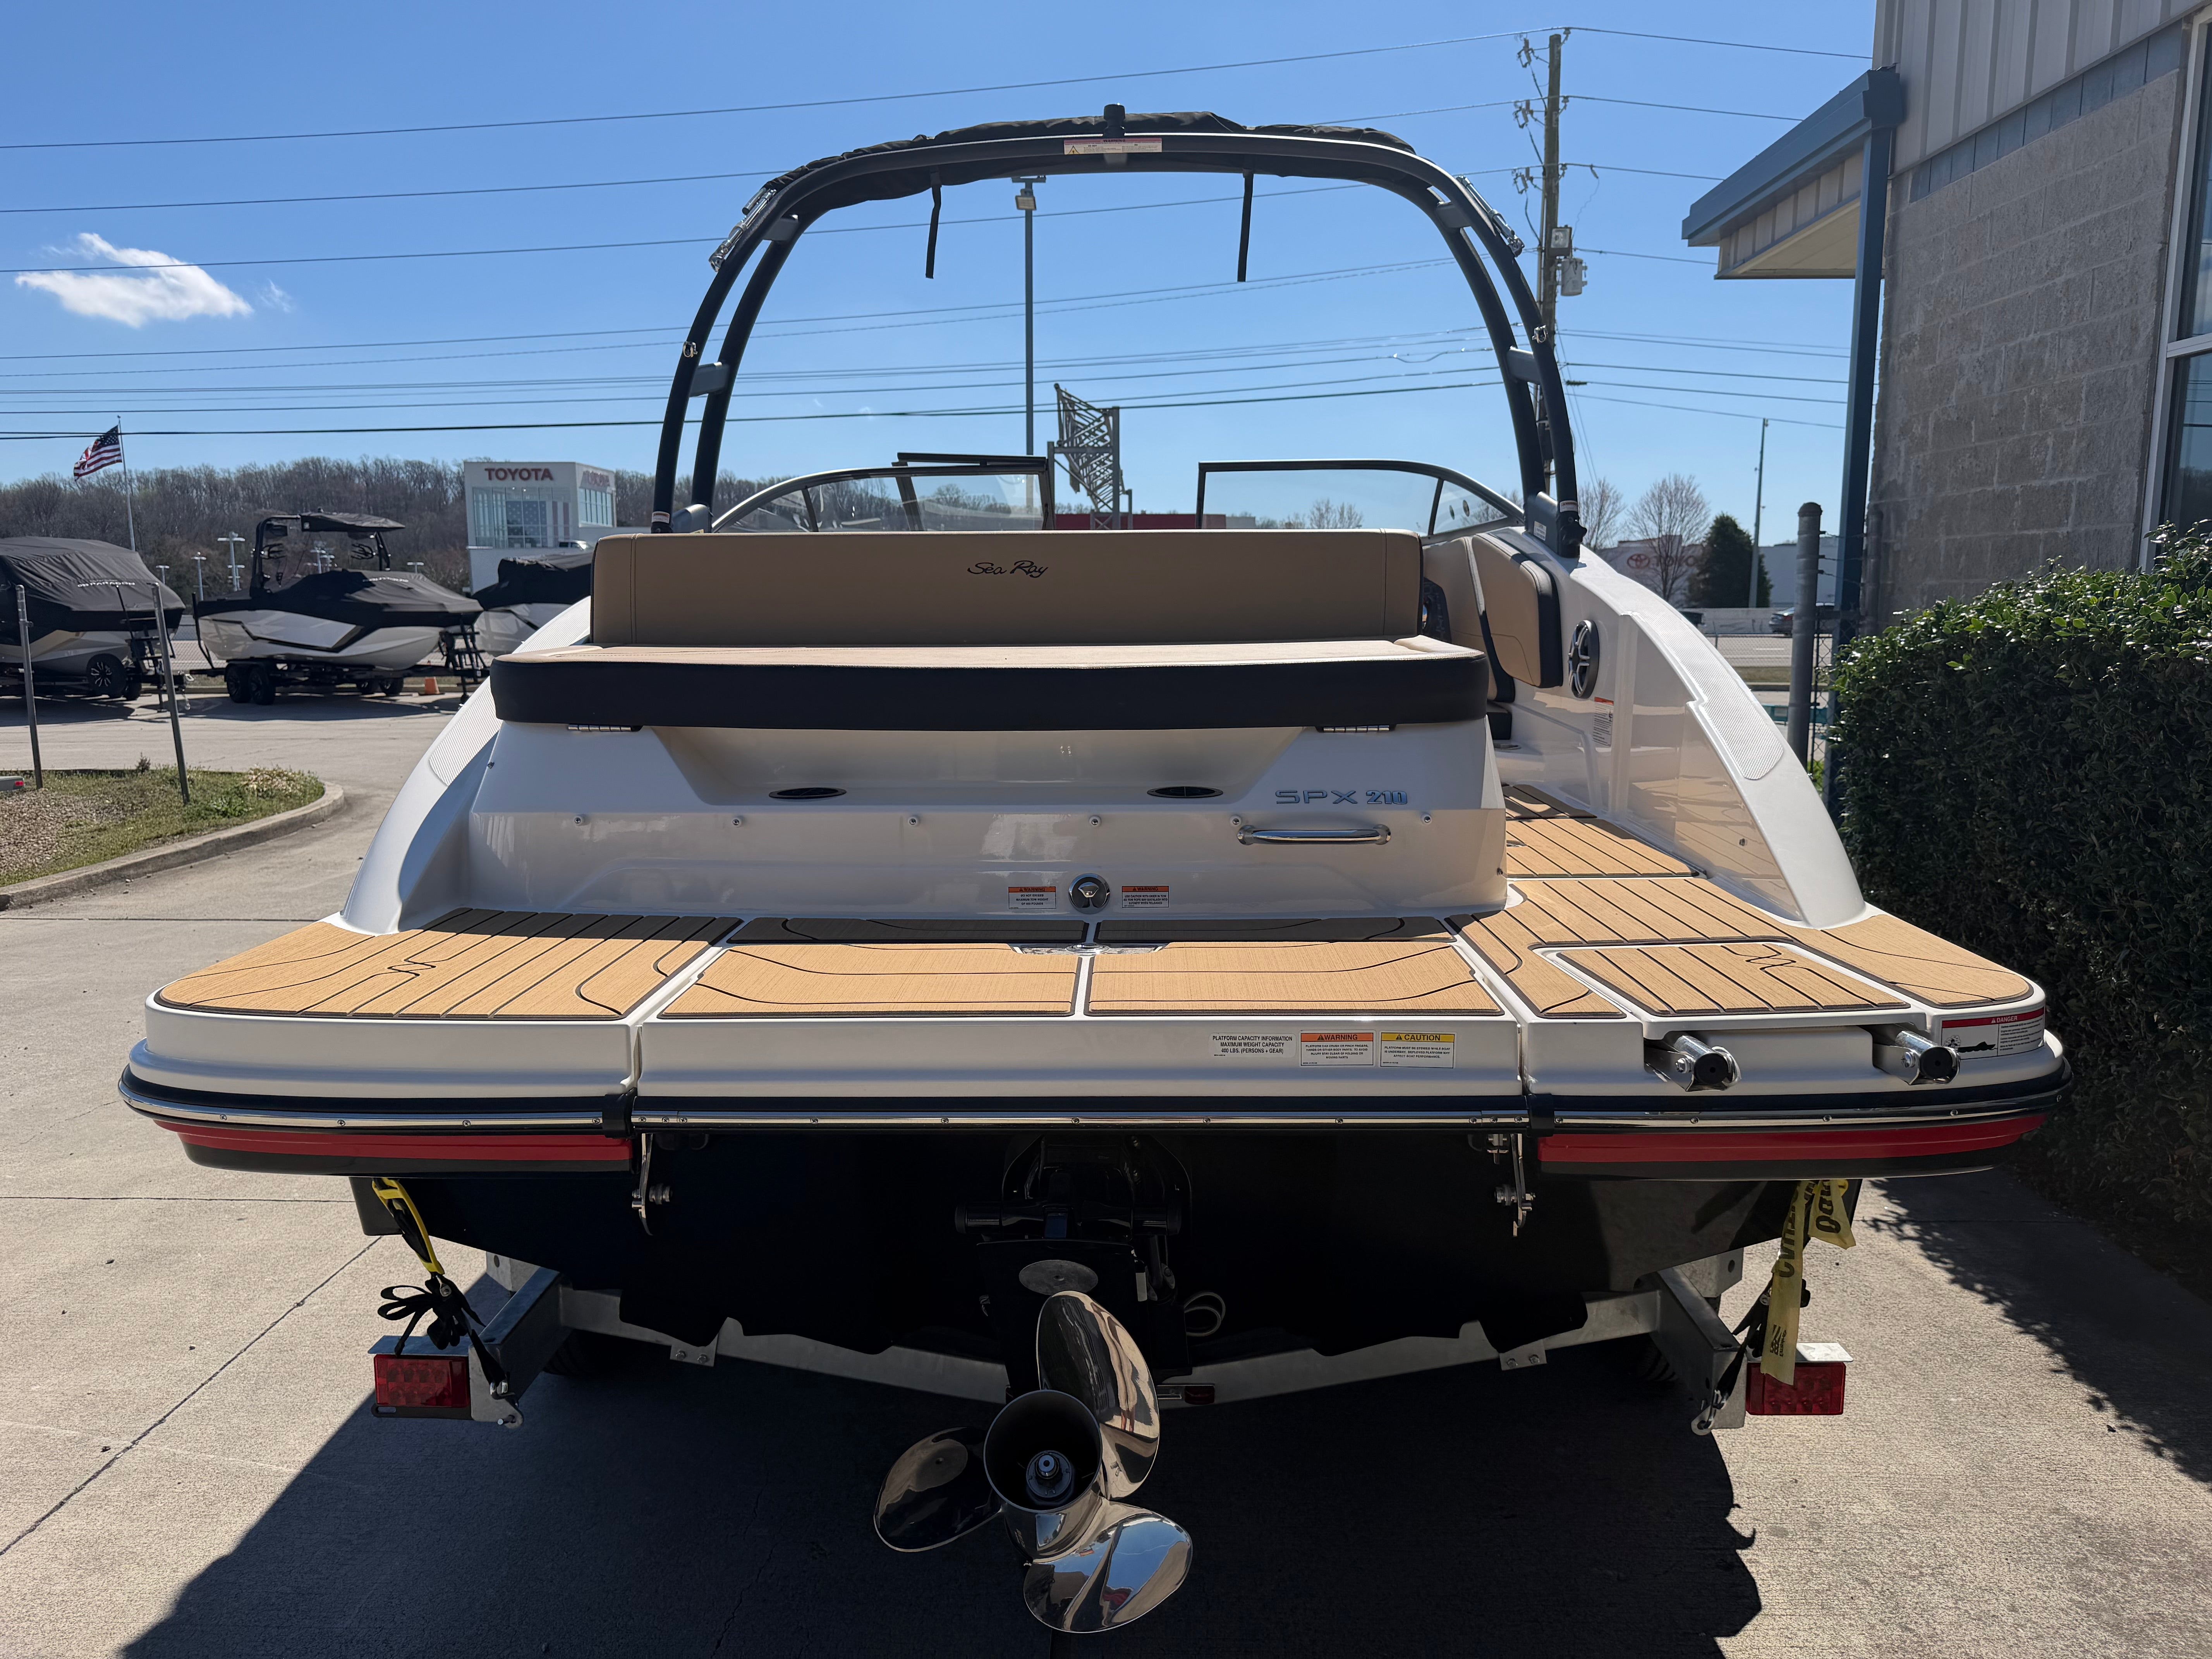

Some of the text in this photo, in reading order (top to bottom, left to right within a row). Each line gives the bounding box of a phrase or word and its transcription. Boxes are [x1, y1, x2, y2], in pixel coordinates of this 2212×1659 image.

[484, 468, 553, 481] TOYOTA
[967, 560, 1049, 578] Sea Ray
[1275, 790, 1408, 805] SPX 210
